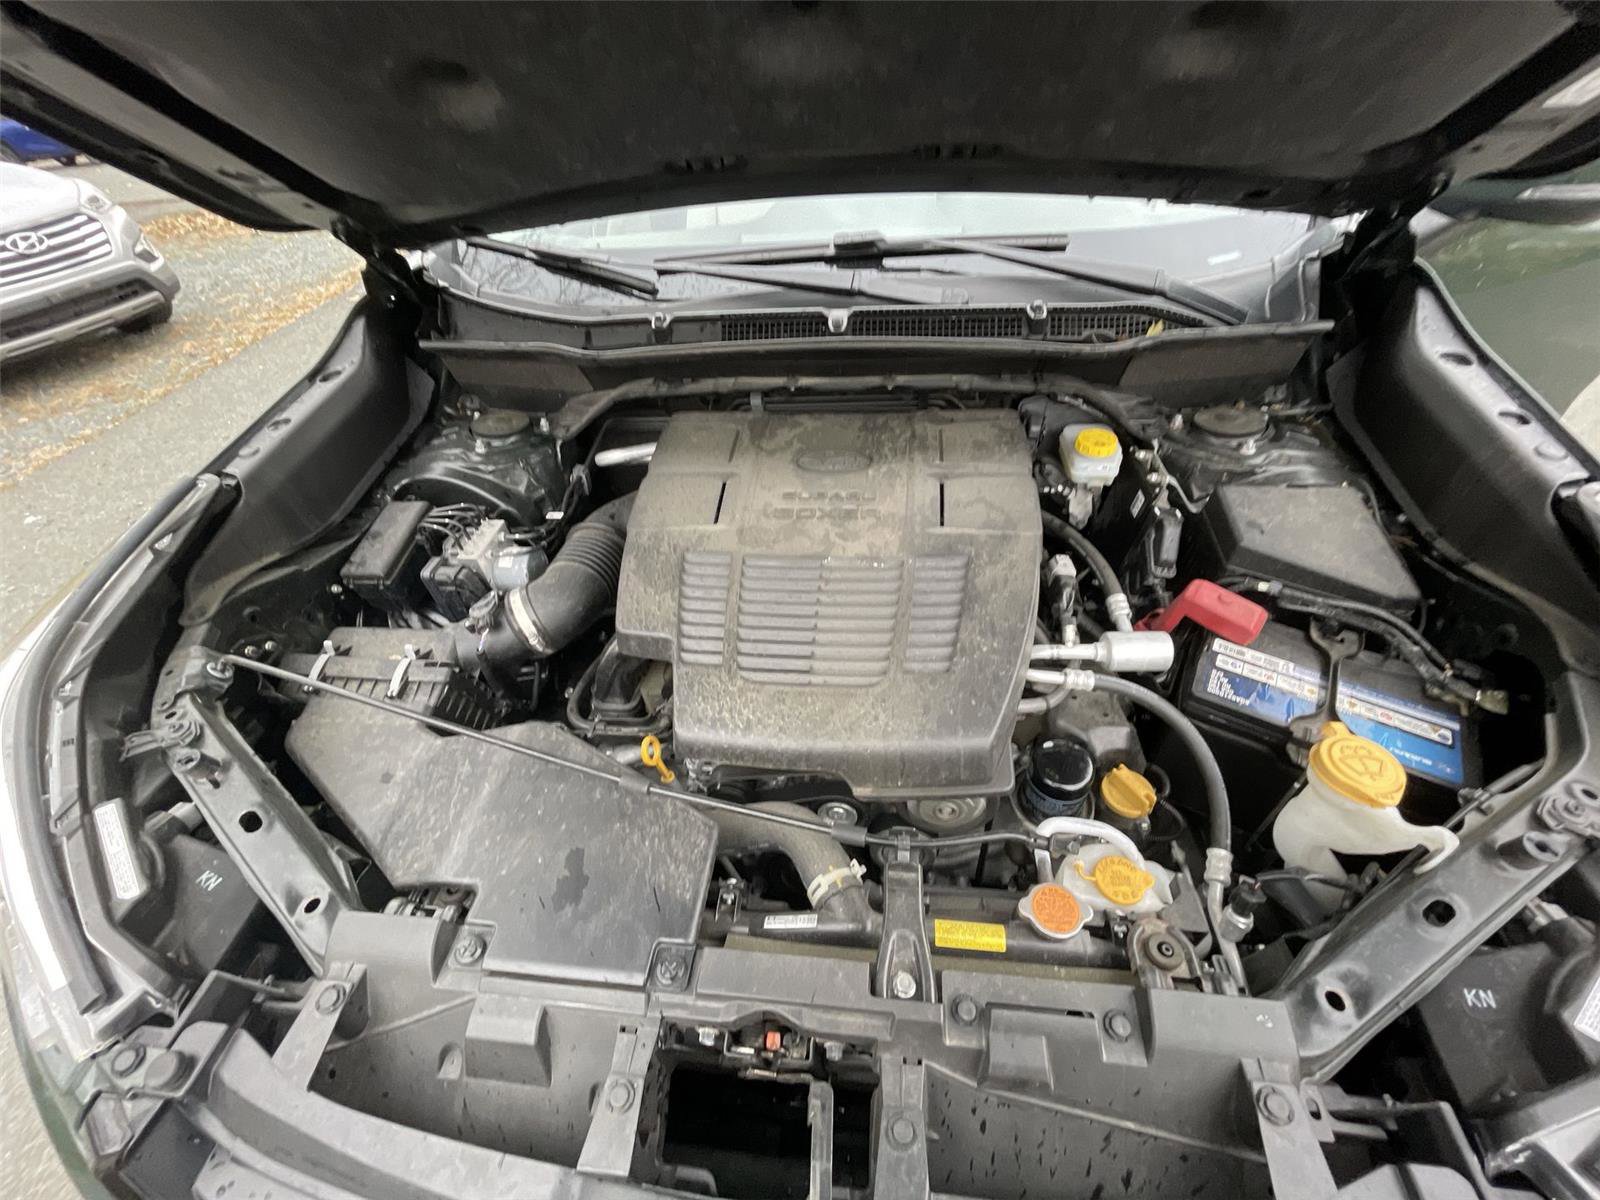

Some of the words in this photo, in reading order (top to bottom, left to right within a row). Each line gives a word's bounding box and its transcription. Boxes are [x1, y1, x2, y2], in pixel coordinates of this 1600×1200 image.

[782, 490, 877, 502] SUBARU
[773, 506, 882, 520] BOXER
[196, 870, 223, 891] KN
[1463, 988, 1497, 1009] KN
